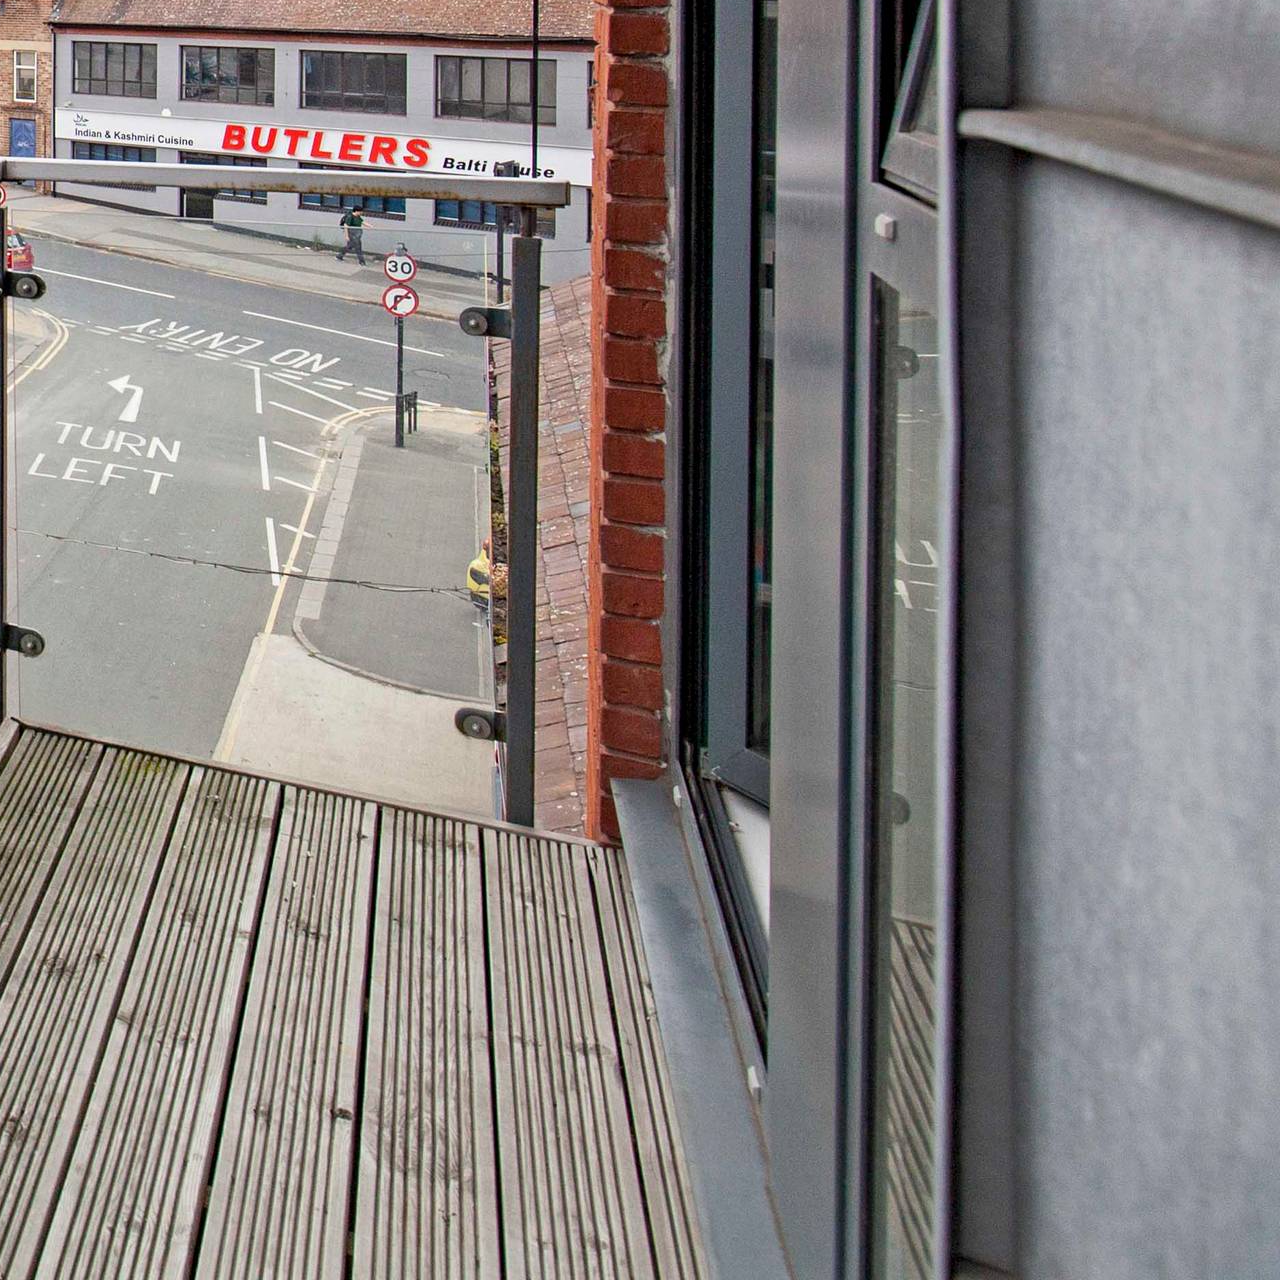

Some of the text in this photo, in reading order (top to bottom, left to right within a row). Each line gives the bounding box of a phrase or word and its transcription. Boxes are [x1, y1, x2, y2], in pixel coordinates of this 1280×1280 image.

[75, 127, 194, 147] Indian & Kashmiri Cuisine
[221, 124, 432, 168] BUTLERS
[443, 156, 487, 173] Balti
[388, 260, 412, 275] 30
[119, 318, 341, 373] NO ENTRY
[55, 420, 182, 463] TURN
[27, 452, 175, 496] LEFT
